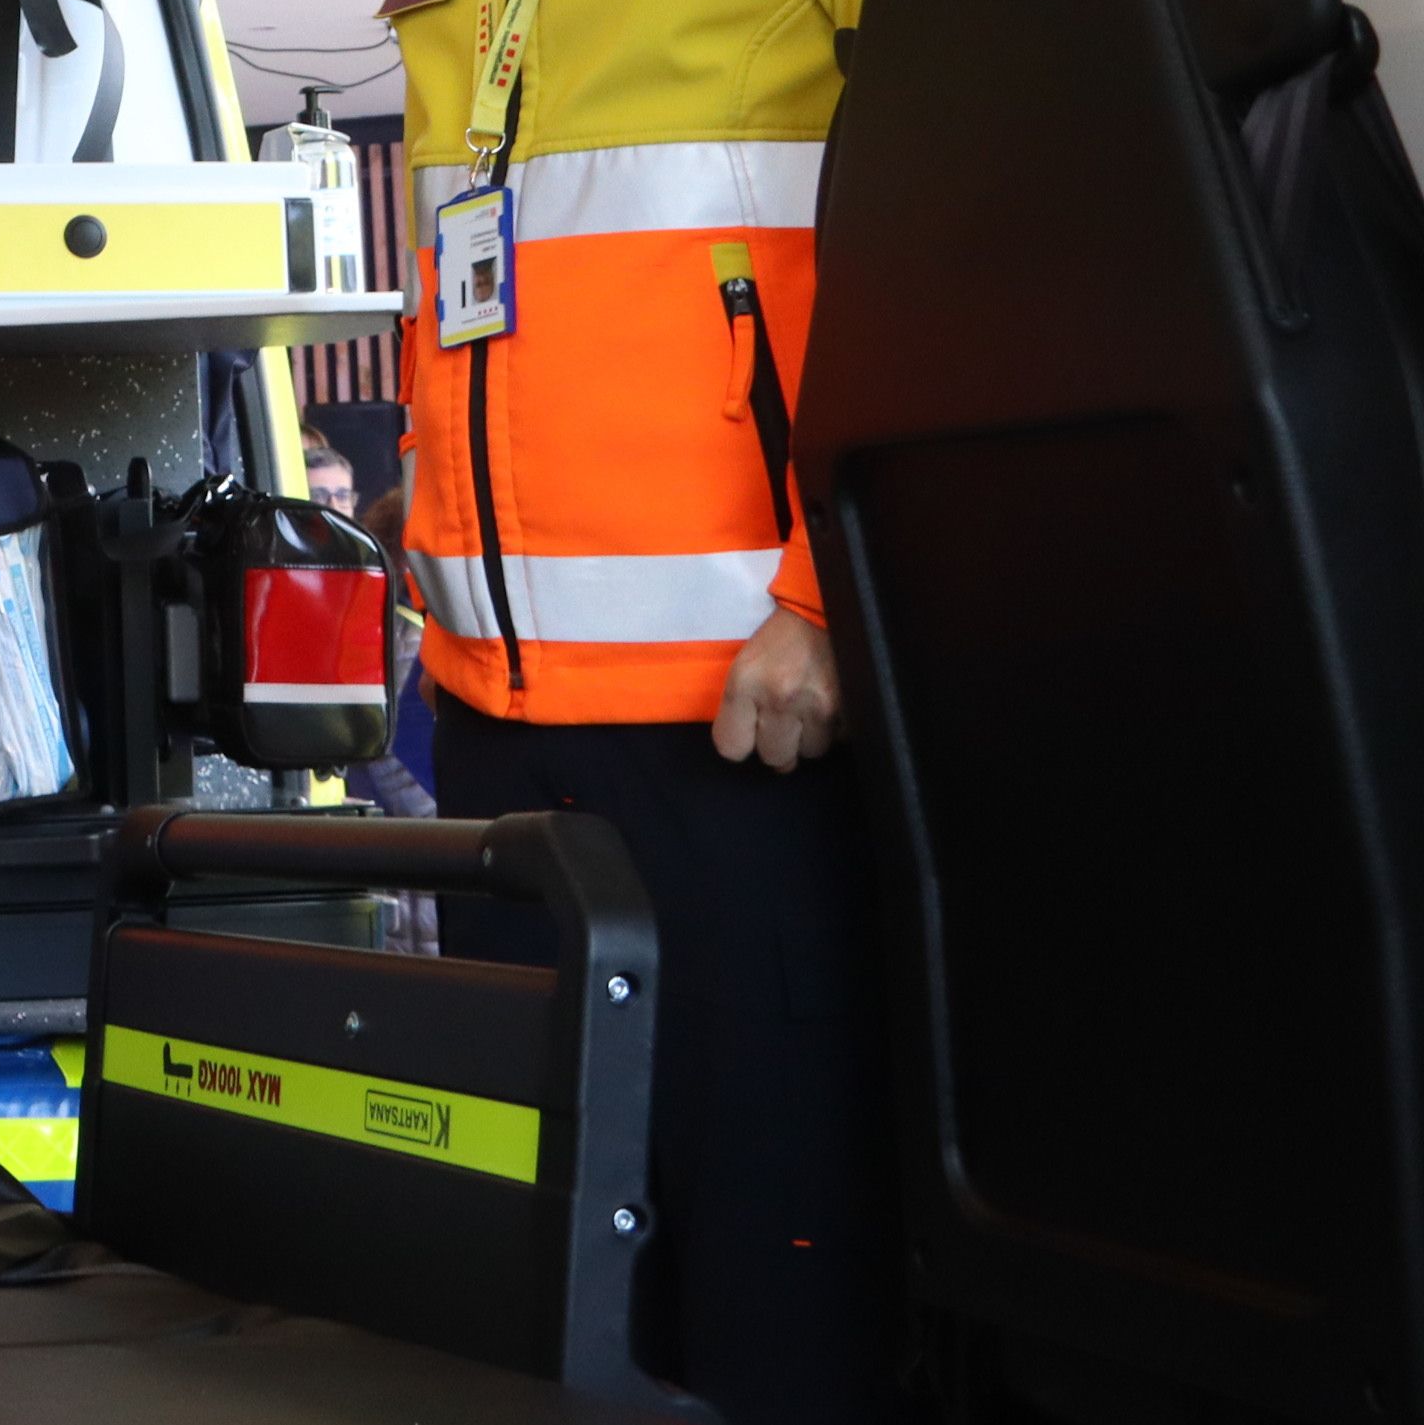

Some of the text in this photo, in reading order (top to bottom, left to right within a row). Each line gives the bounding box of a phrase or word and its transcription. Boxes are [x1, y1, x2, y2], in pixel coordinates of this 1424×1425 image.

[197, 1058, 283, 1108] MAX 100KG
[368, 1100, 430, 1133] KARTSANA
